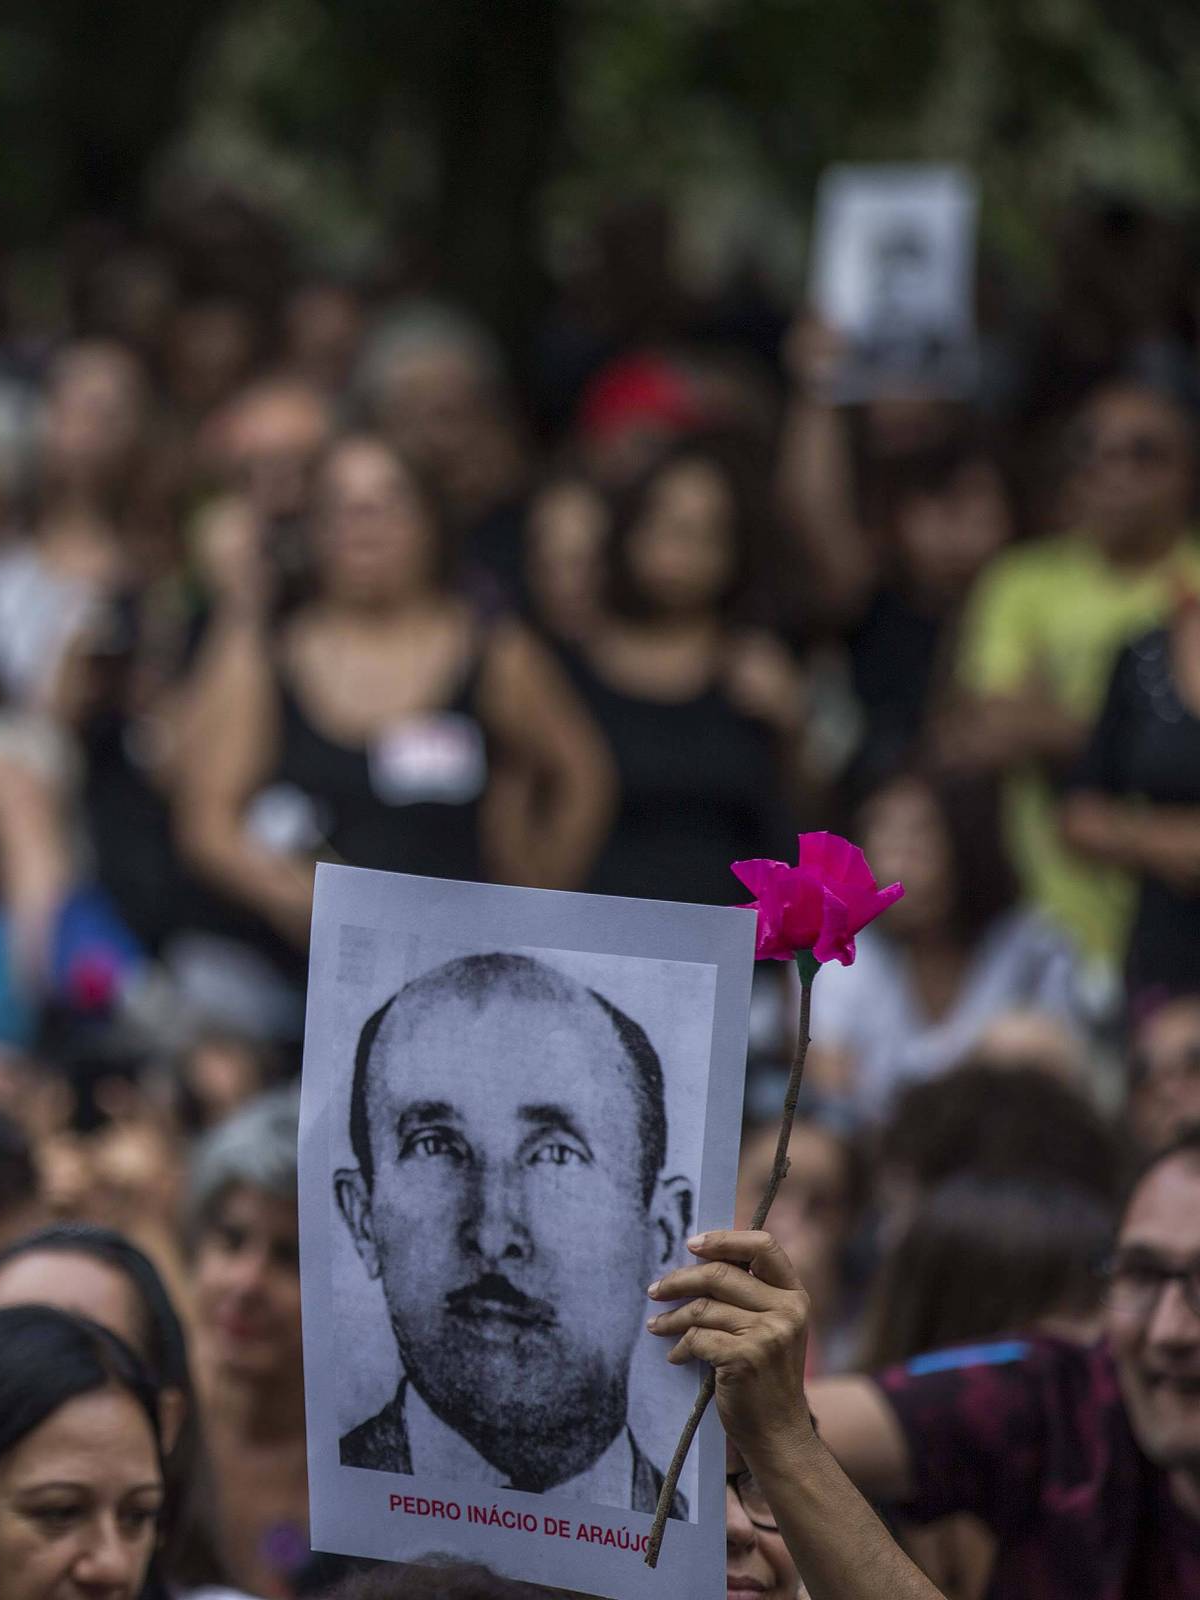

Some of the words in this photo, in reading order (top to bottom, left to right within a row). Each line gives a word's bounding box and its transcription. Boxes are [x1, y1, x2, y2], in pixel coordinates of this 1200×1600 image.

[389, 1494, 461, 1520] PEDRO
[467, 1504, 537, 1532] INÁCIO
[544, 1517, 571, 1538] DE
